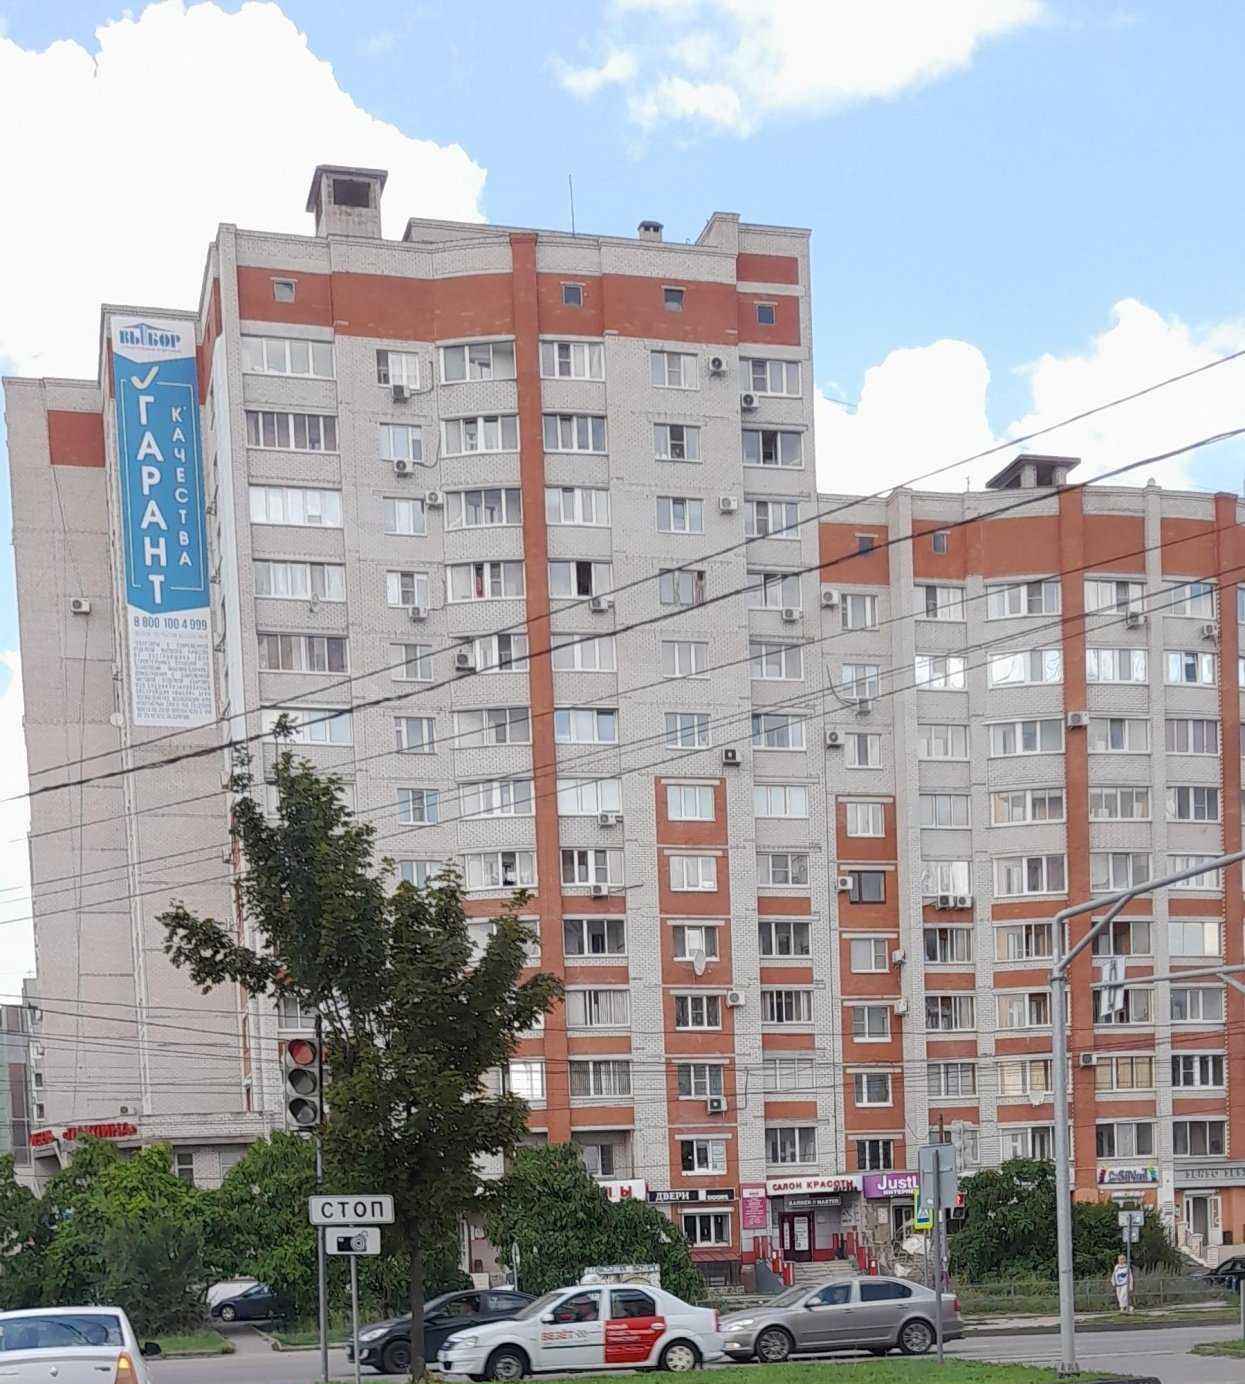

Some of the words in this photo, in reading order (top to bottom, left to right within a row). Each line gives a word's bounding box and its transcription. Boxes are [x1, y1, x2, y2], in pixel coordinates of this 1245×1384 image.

[119, 326, 181, 348] ВЫБОР
[171, 406, 193, 567] КАЧЕСТВА
[136, 395, 168, 604] ГАРАНТ
[142, 616, 160, 628] 800
[164, 617, 179, 629] 100
[182, 618, 188, 629] 4
[190, 619, 207, 630] 999
[772, 1182, 802, 1191] САЛОН
[655, 1191, 690, 1201] ДВЕРИ
[321, 1201, 384, 1218] СТОП
